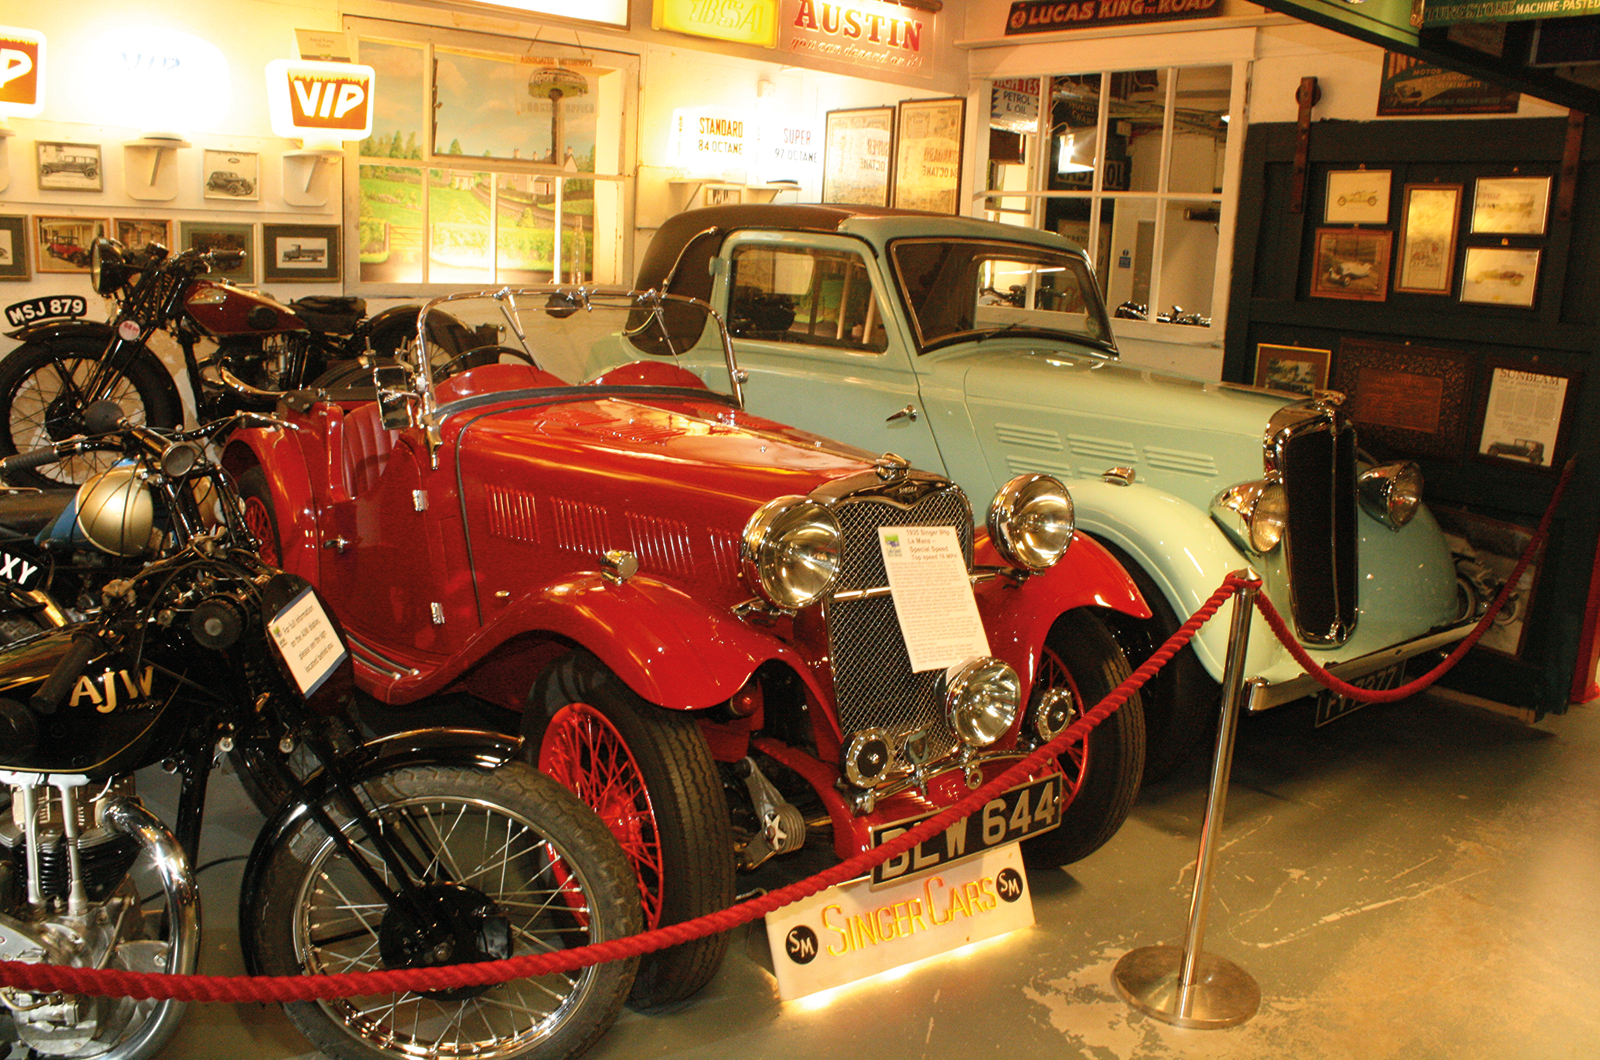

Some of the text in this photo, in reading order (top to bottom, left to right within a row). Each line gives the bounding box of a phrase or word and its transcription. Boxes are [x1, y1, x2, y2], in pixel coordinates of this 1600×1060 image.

[689, 0, 764, 33] BSA
[1027, 3, 1094, 25] LUCAS
[1098, 0, 1145, 19] KING
[1157, 0, 1216, 14] ROAD
[793, 0, 923, 52] AUSTIN
[790, 37, 816, 51] you
[818, 41, 841, 54] can
[844, 44, 891, 64] depend
[293, 79, 366, 120] VIP
[1003, 90, 1031, 105] PETROL
[1006, 103, 1027, 114] & OIL
[699, 117, 744, 138] STANDARD
[783, 127, 812, 146] SUPER
[698, 139, 743, 155] 84 OCTANE
[774, 148, 818, 163] 97 OCTANE
[9, 299, 84, 324] MSJ 879
[1499, 368, 1560, 386] SUNBEAM
[68, 665, 155, 714] AJW
[982, 781, 1056, 846] 644
[998, 872, 1020, 897] SM
[820, 875, 999, 957] SINGER CARS
[788, 930, 815, 959] SM
